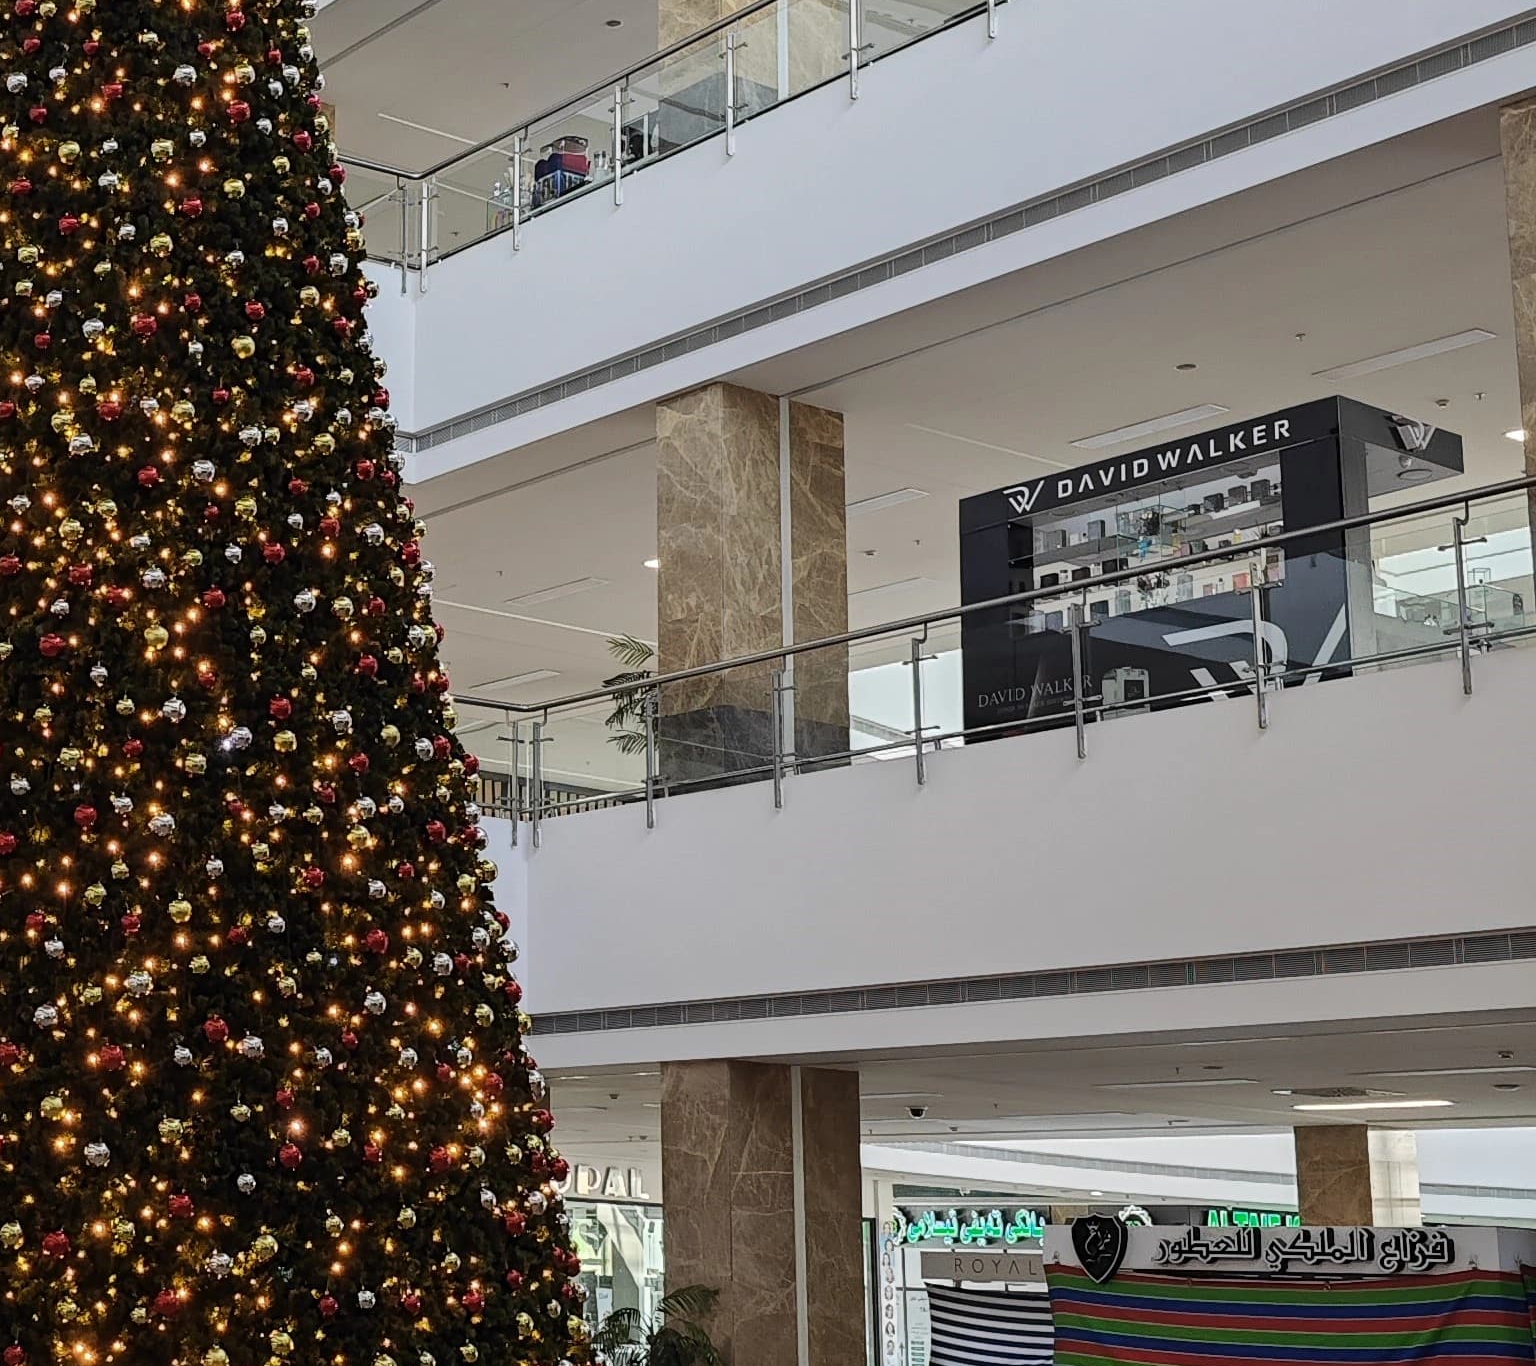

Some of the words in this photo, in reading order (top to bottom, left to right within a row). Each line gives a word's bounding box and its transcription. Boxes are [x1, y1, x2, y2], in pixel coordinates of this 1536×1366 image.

[1056, 457, 1150, 500] DAVID
[1156, 418, 1293, 471] WALKER
[978, 687, 1026, 709] DAVID
[1030, 674, 1093, 699] WALKR
[1151, 1225, 1258, 1266] للعطور
[1265, 1226, 1368, 1273] الملكي
[954, 1257, 1038, 1276] ROYAL
